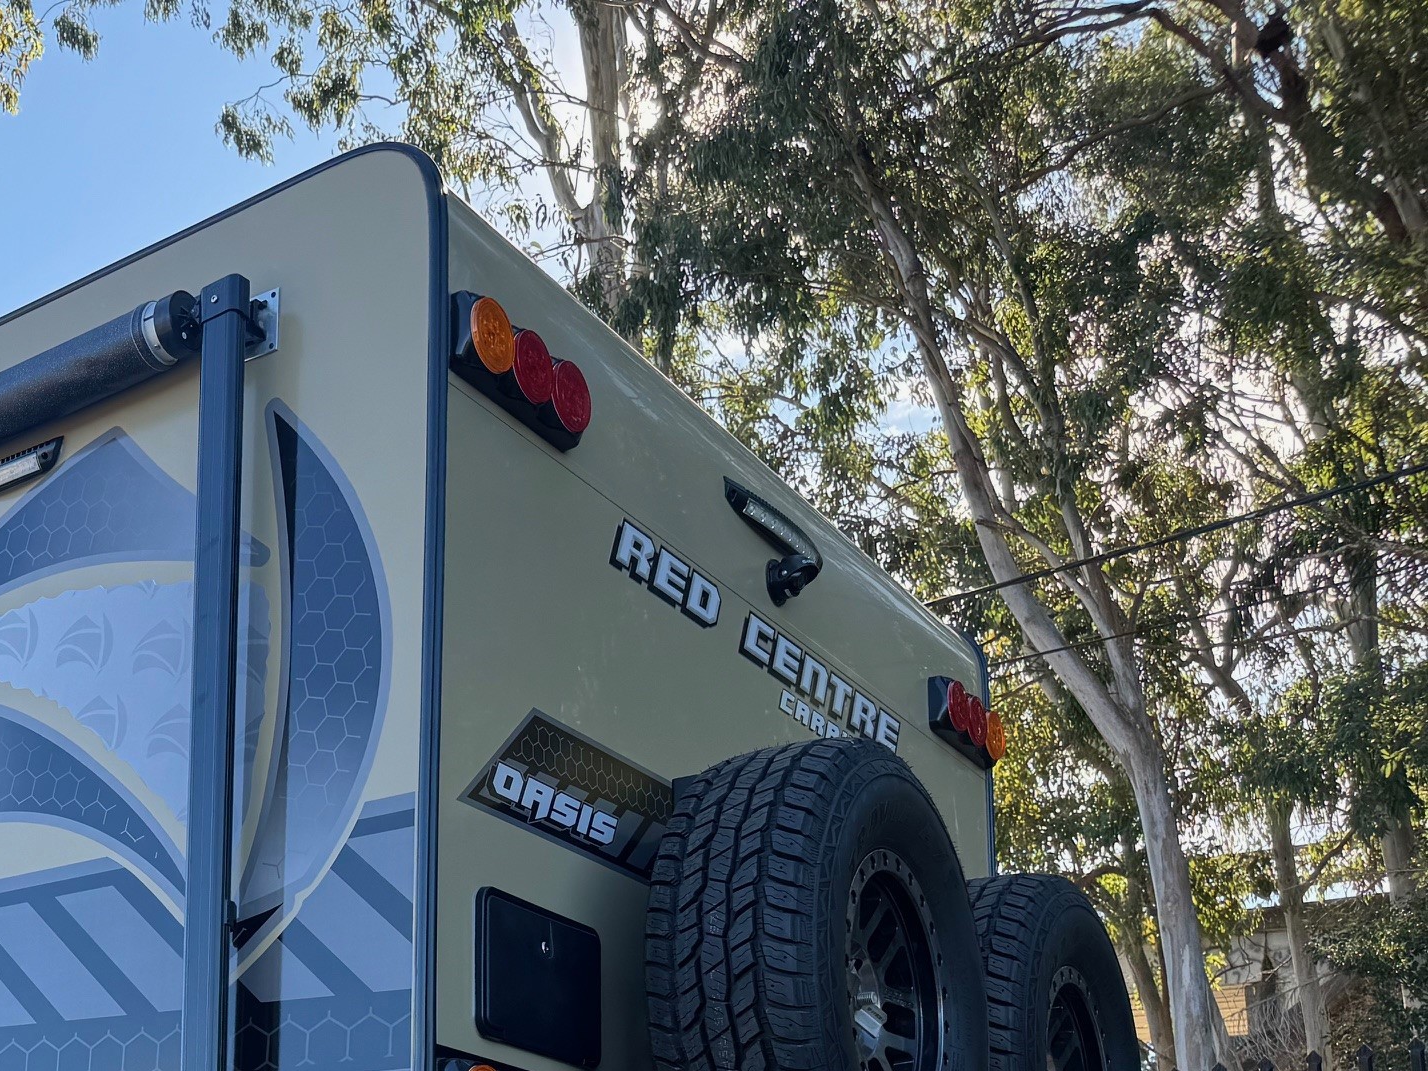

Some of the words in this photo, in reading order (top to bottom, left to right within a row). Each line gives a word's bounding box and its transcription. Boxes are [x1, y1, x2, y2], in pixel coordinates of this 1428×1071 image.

[609, 517, 722, 627] RED
[739, 610, 901, 752] CENTRE
[779, 688, 853, 738] CARA
[488, 759, 619, 846] OASIS
